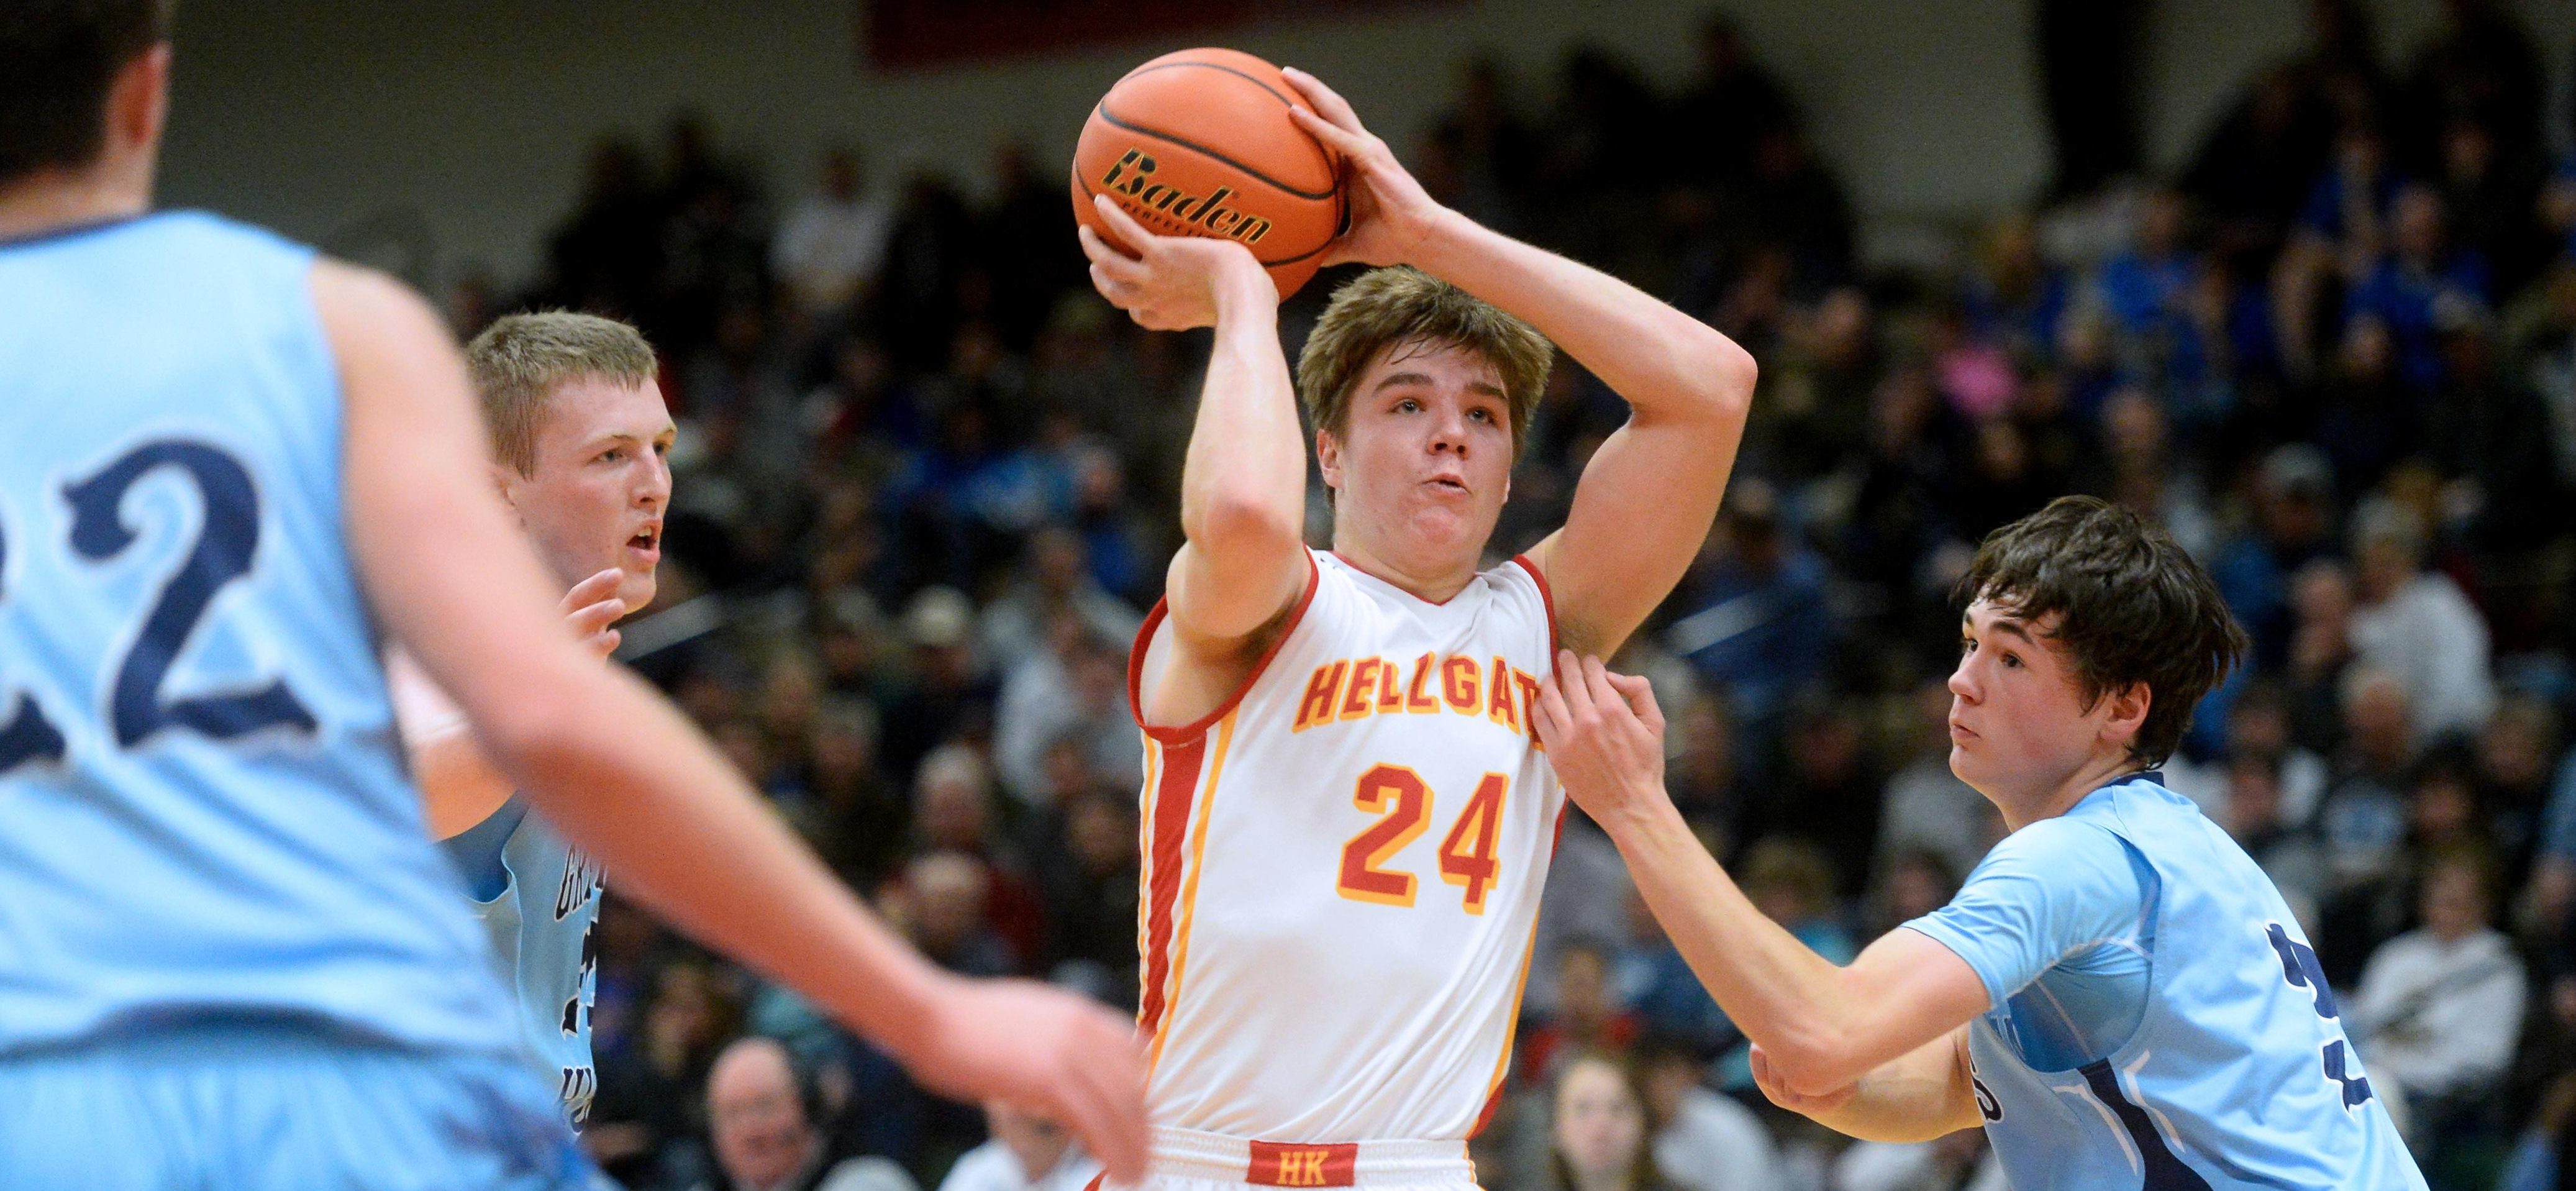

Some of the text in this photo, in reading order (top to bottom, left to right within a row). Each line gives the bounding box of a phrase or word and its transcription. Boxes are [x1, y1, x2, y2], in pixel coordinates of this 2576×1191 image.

[1101, 147, 1272, 245] Baden
[1291, 650, 1548, 752] HELLGAT
[1336, 762, 1510, 916] 24
[1277, 1151, 1329, 1185] HK
